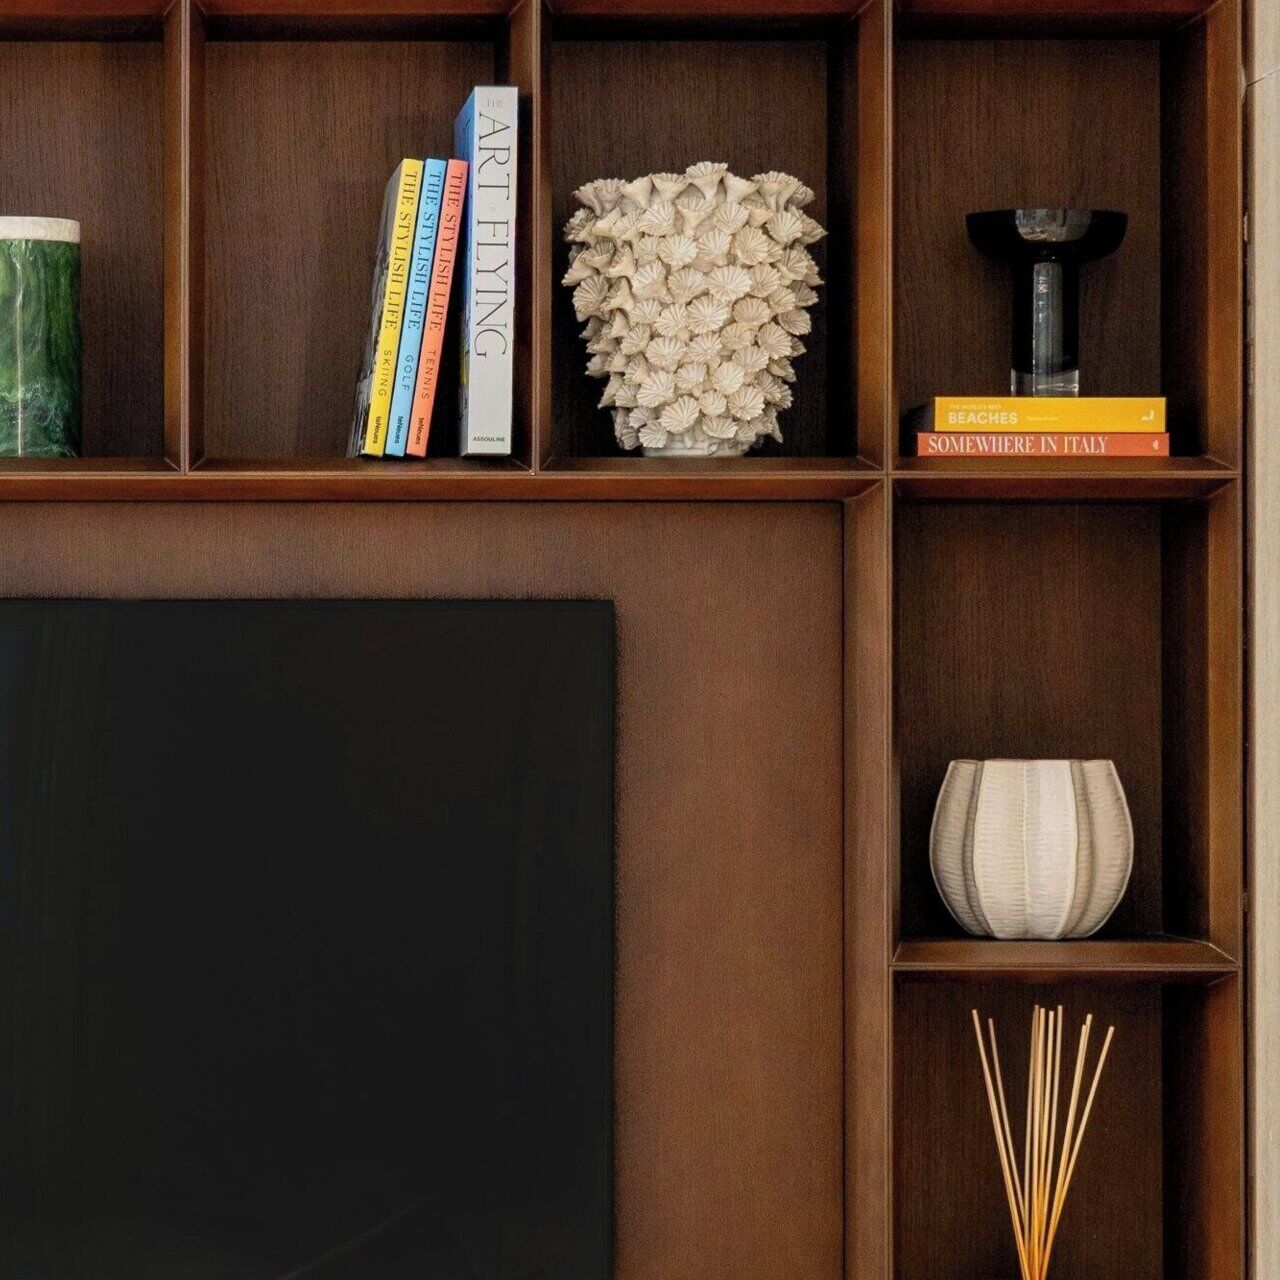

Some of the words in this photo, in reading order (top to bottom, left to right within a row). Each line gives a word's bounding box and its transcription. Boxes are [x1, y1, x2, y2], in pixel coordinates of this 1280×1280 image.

[477, 111, 511, 200] ART
[400, 171, 418, 206] THE
[424, 171, 442, 206] THE
[446, 172, 464, 208] THE
[389, 210, 413, 282] STYLISH
[414, 211, 436, 283] STYLISH
[436, 212, 458, 286] STYLISH
[384, 285, 403, 331] LIFE
[407, 285, 426, 331] LIFE
[428, 286, 448, 333] LIFE
[474, 218, 510, 358] FLYING
[378, 349, 393, 397] SKIING
[402, 354, 414, 392] GOLF
[421, 349, 437, 400] TENNIS
[372, 416, 382, 445] teNeues
[394, 415, 405, 445] teNeues
[414, 416, 426, 446] teNeues
[948, 412, 1019, 425] BEACHES
[928, 435, 1035, 454] SOMEWHERE
[1040, 435, 1057, 454] IN
[1063, 435, 1108, 454] ITALY
